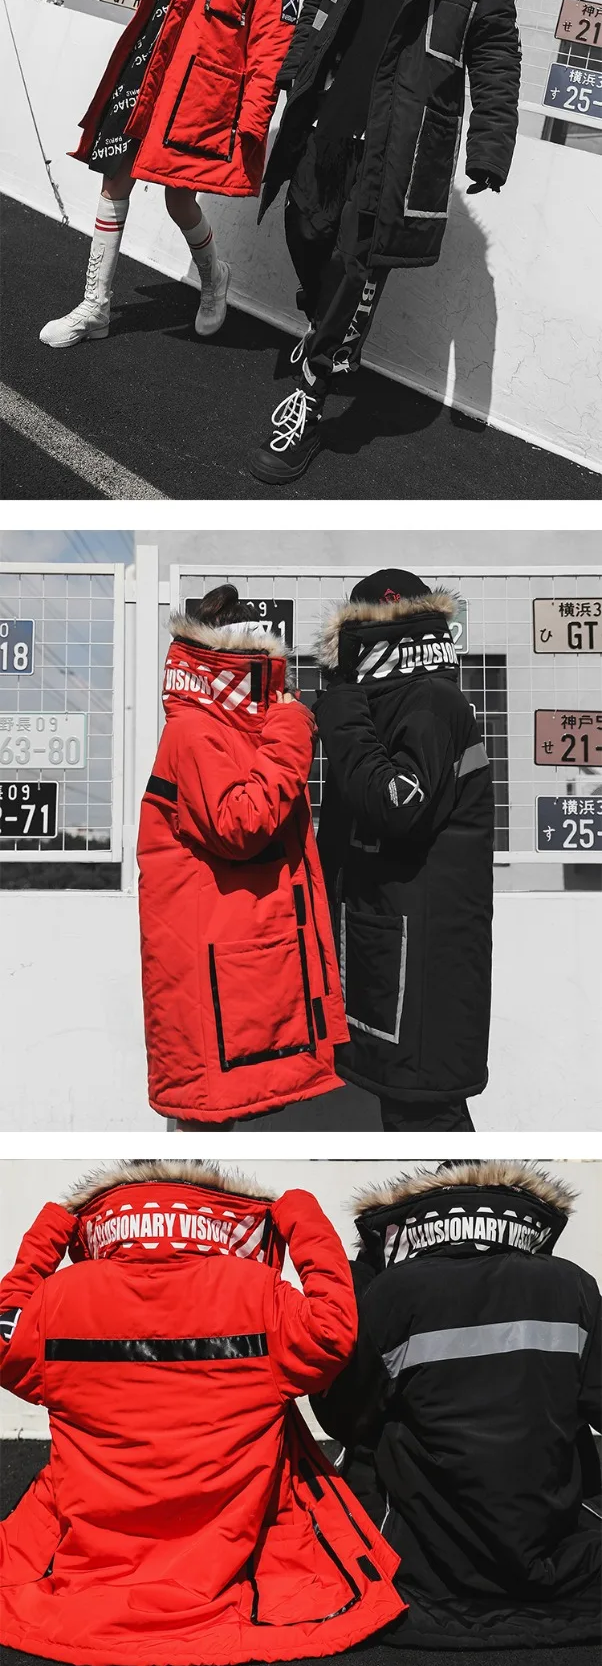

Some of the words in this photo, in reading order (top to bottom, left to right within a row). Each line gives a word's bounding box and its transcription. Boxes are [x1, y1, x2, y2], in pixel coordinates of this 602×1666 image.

[562, 21, 573, 33] せ
[550, 86, 561, 100] す
[540, 627, 552, 643] ひ
[0, 736, 80, 765] 63-80
[542, 740, 554, 754] せ
[0, 784, 30, 801] 09
[0, 804, 49, 834] -71
[542, 825, 555, 842] す
[180, 1212, 233, 1245] VISION
[408, 1216, 508, 1250] ILLUSIONARY
